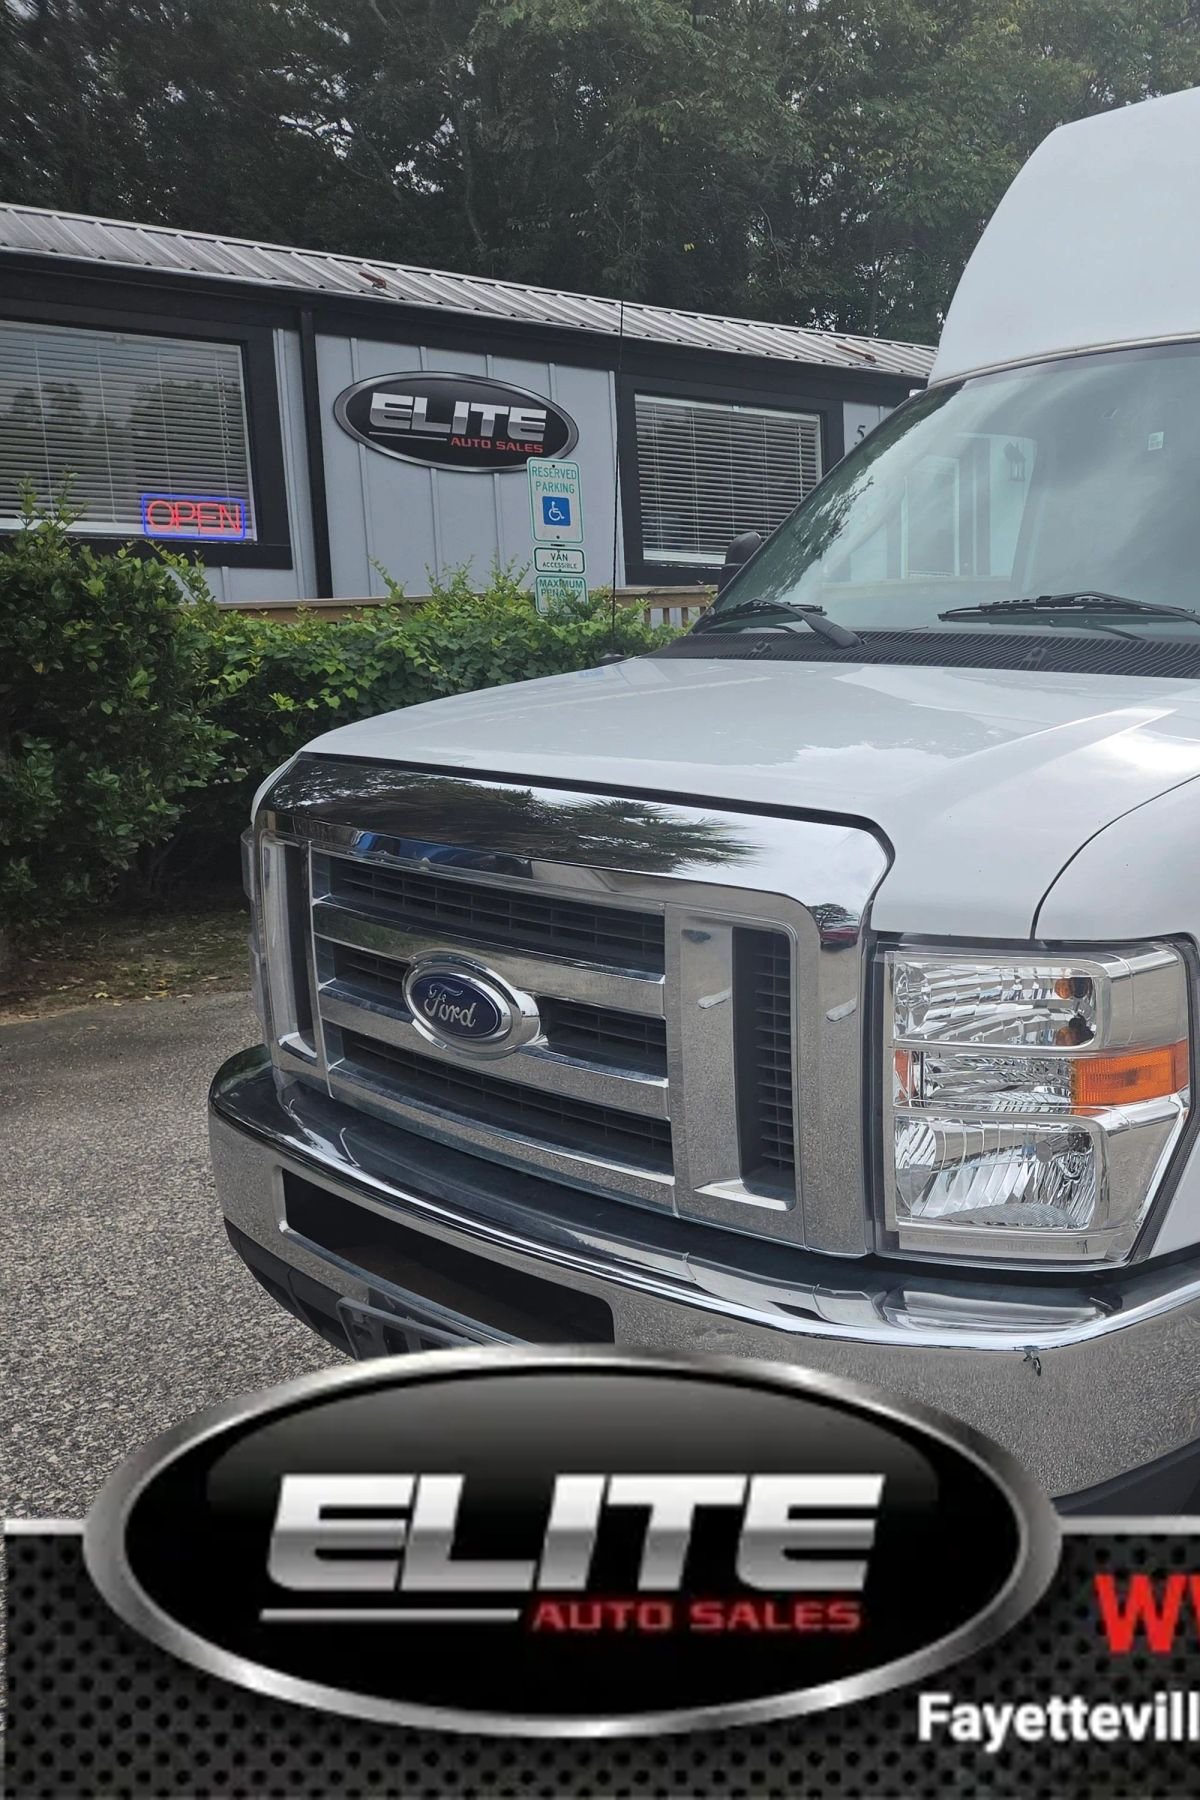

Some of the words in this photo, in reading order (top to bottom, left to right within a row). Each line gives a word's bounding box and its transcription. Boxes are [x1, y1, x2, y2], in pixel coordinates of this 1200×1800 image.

[369, 392, 547, 442] ELITE
[450, 436, 491, 450] AUTO
[495, 440, 544, 454] SALES
[532, 466, 577, 480] RESERVED
[535, 481, 575, 494] PARKING
[147, 500, 241, 533] OPEN
[550, 552, 568, 562] VAN
[542, 561, 578, 570] ACCESSIBLE
[541, 588, 582, 600] PENATY
[424, 982, 477, 1028] Ford
